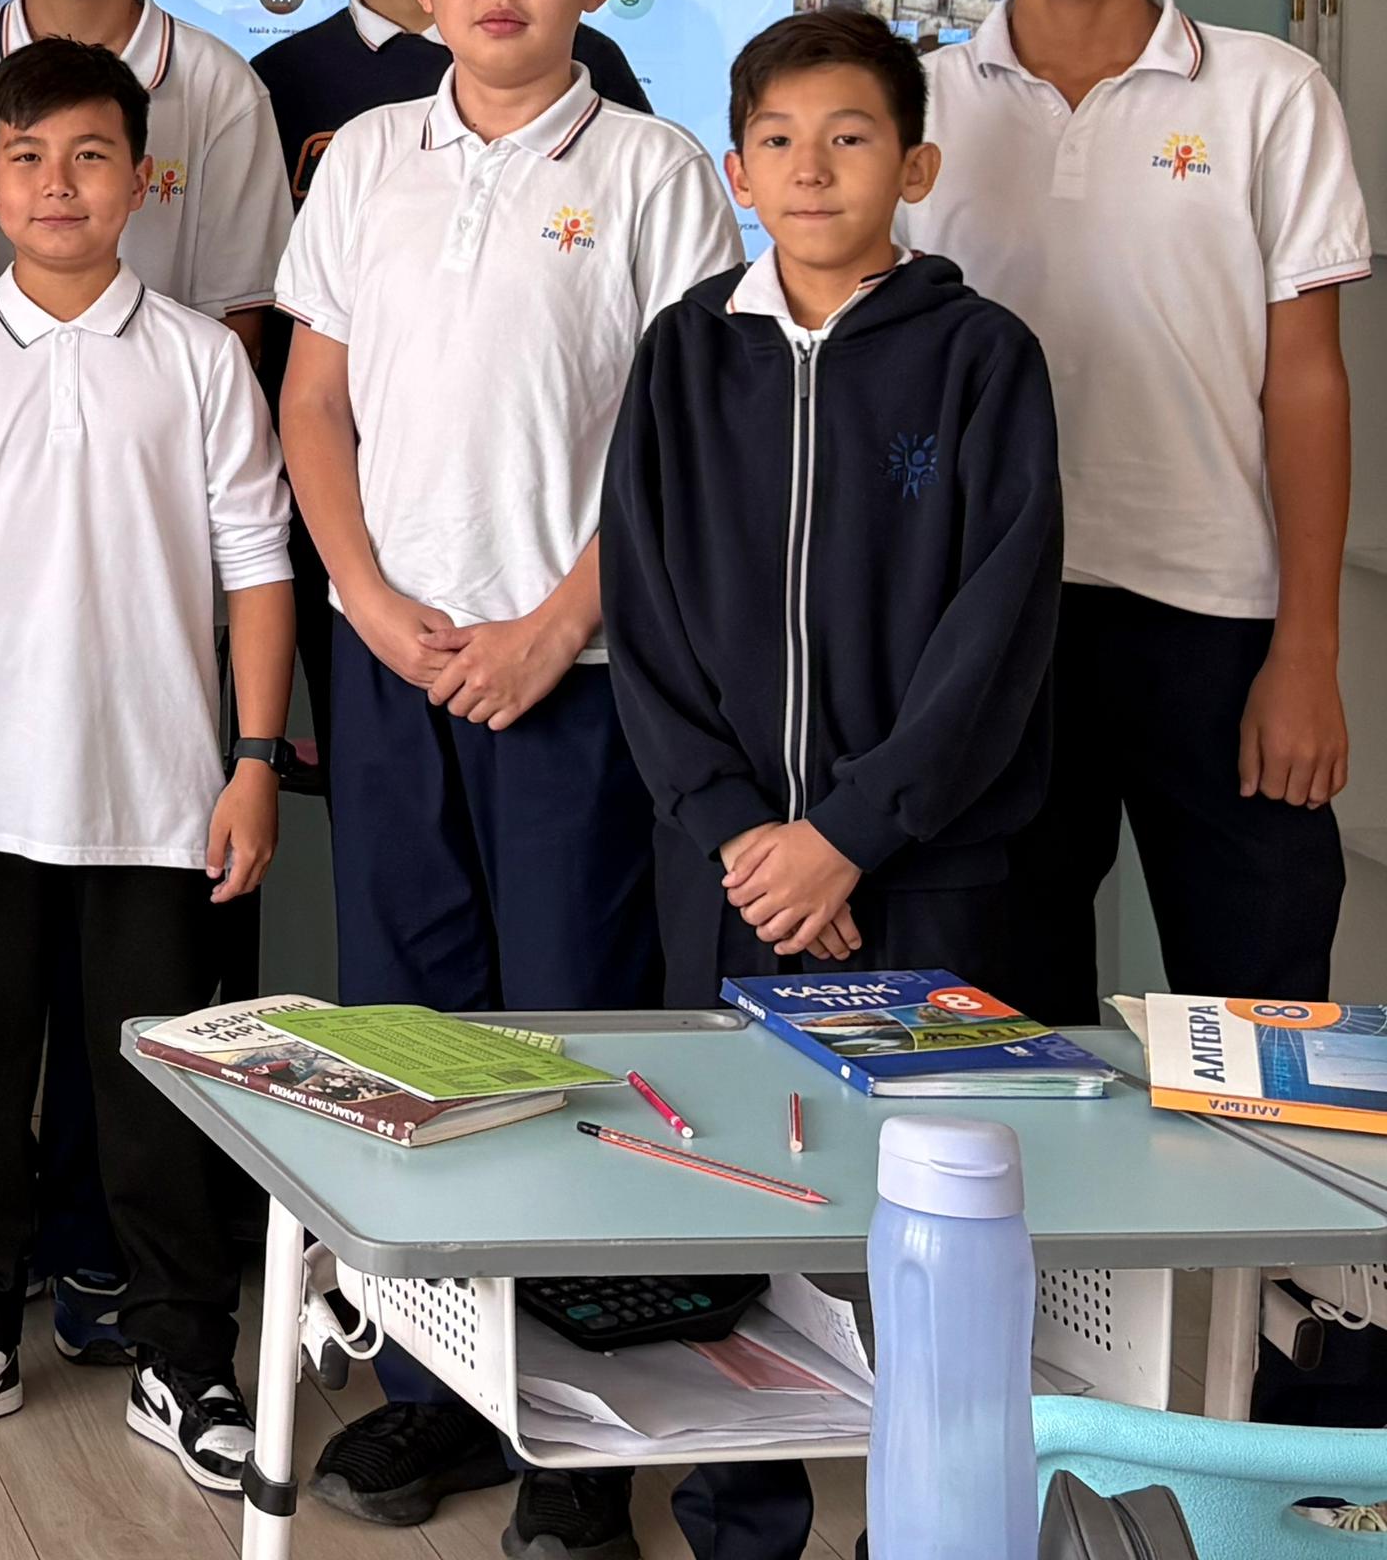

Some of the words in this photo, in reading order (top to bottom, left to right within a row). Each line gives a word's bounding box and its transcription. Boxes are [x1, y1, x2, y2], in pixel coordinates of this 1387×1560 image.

[811, 995, 889, 1007] ТІЛІ
[936, 993, 983, 1010] 8
[1253, 1003, 1310, 1020] 8
[1188, 1004, 1226, 1083] АЛГЕБРА
